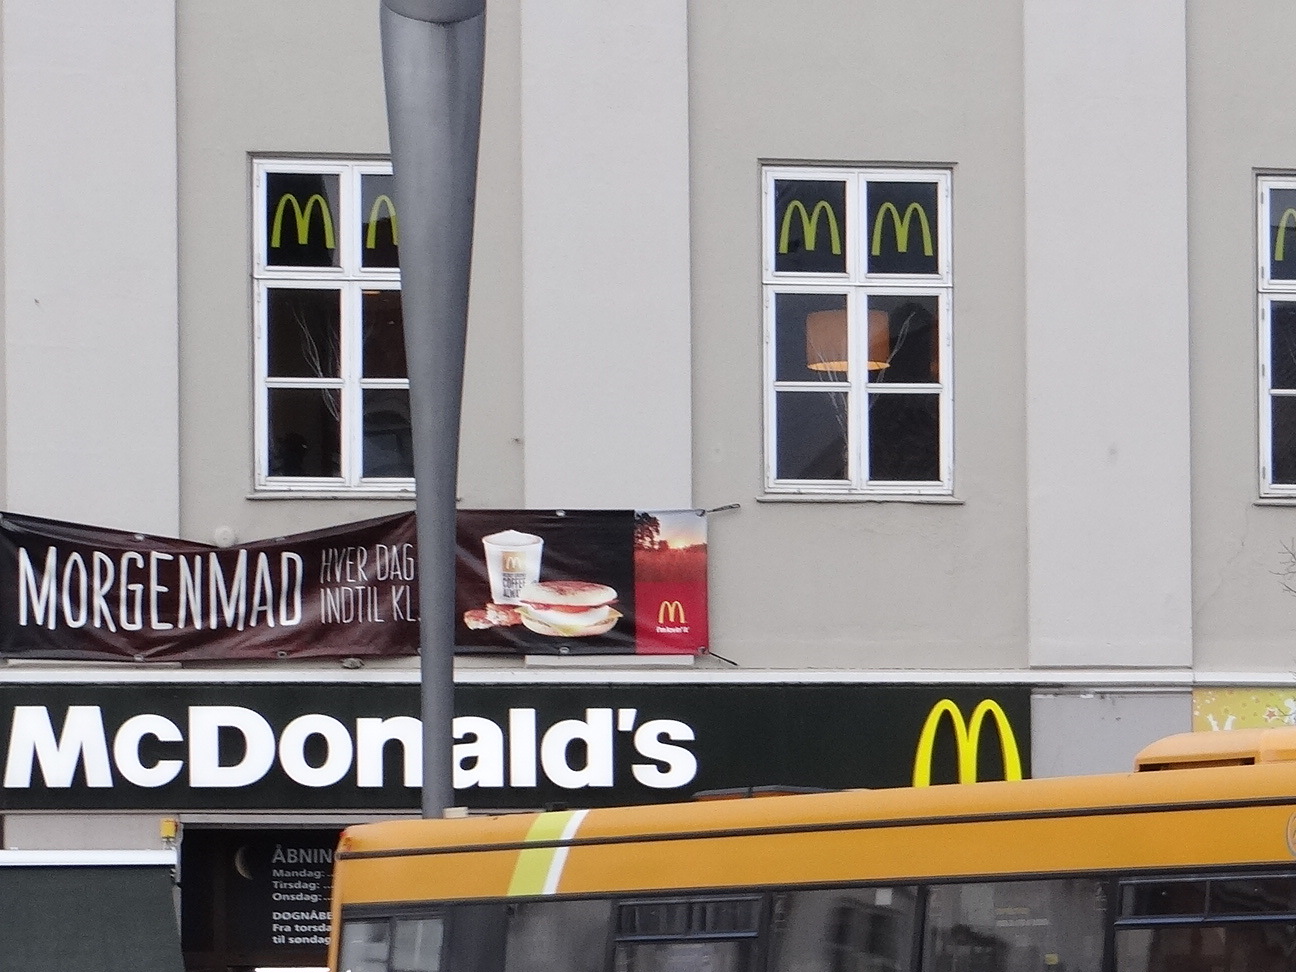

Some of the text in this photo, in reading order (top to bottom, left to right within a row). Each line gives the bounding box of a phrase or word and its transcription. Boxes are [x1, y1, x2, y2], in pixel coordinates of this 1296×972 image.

[320, 543, 415, 584] HVER DAG
[18, 546, 303, 632] MORGENMAD
[320, 585, 421, 624] INDTIL KL.
[4, 705, 698, 789] McDonald's
[272, 869, 325, 879] Mandag:
[272, 880, 320, 891] Tirsdag:
[272, 892, 322, 903] Onsdag:
[272, 923, 292, 932] Fra
[272, 935, 286, 944] til
